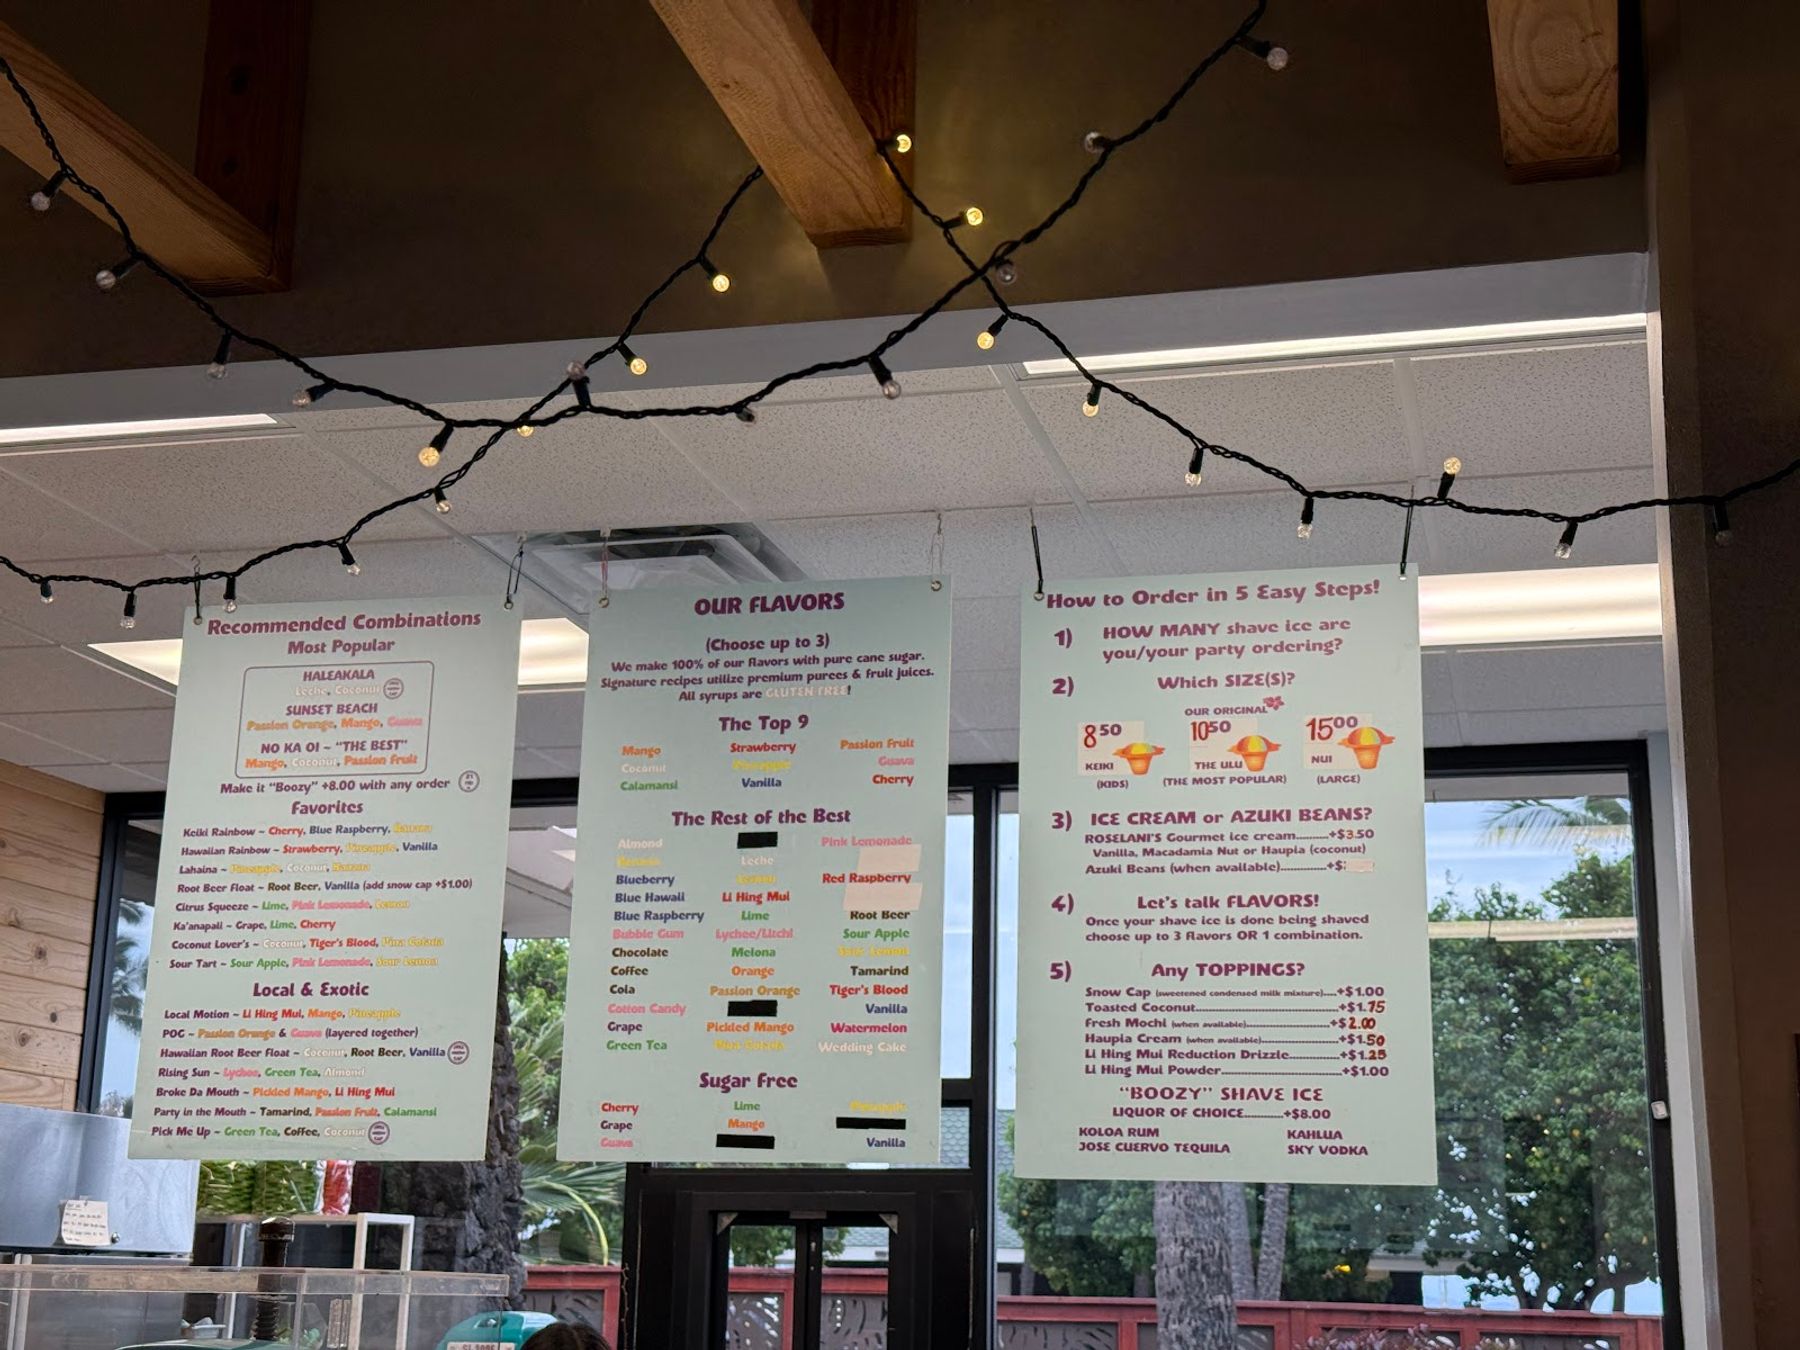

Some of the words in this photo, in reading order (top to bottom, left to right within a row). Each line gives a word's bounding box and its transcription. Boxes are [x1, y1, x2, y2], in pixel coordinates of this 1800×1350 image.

[1046, 591, 1096, 609] How
[1103, 594, 1124, 607] to
[1132, 589, 1199, 605] Order
[1207, 587, 1228, 602] in
[1236, 585, 1248, 601] 5
[1257, 584, 1306, 604] Easy
[1315, 579, 1380, 601] Steps!
[694, 597, 742, 616] OUR
[749, 592, 845, 614] FLAVORS
[207, 615, 346, 635] Recommended
[353, 611, 481, 630] Combinations
[1103, 625, 1154, 639] HOW
[1160, 623, 1220, 637] MANY
[1227, 622, 1279, 635] shave
[1285, 620, 1312, 632] ice
[1319, 620, 1350, 631] are
[288, 641, 327, 655] Most
[332, 638, 395, 657] Popular
[706, 637, 765, 654] (Choose
[770, 639, 790, 653] up
[795, 637, 811, 648] to
[816, 632, 830, 649] 3)
[1102, 645, 1189, 664] you/your
[1195, 644, 1245, 661] party
[1252, 638, 1343, 656] ordering?
[611, 662, 632, 672] We
[636, 661, 668, 671] make
[672, 659, 703, 670] 100%
[708, 659, 720, 669] of
[723, 660, 745, 668] our
[748, 655, 789, 667] flavors
[793, 654, 820, 666] with
[824, 655, 853, 668] pure
[856, 654, 885, 663] cane
[888, 652, 925, 665] sugar.
[303, 669, 375, 682] HALEAKALA
[601, 678, 657, 691] Signature
[660, 675, 703, 689] recipes
[707, 673, 744, 684] utilize
[747, 673, 803, 687] premium
[807, 671, 848, 684] purees
[852, 669, 861, 680] &
[895, 667, 934, 681] juices.
[1157, 676, 1218, 690] Which
[1225, 671, 1295, 688] SIZE(S)?
[286, 704, 333, 716] SUNSET
[336, 703, 378, 714] BEACH
[718, 716, 752, 732] The
[758, 715, 792, 735] Top
[798, 714, 809, 729] 9
[261, 743, 280, 754] NO
[284, 742, 302, 753] KA
[305, 742, 320, 753] OI
[730, 742, 796, 754] Strawberry
[1311, 755, 1332, 764] NUI
[1085, 762, 1114, 771] KEIKI
[220, 782, 254, 794] Make
[256, 782, 266, 793] it
[321, 780, 356, 791] +8.00
[359, 779, 386, 791] with
[390, 781, 412, 793] any
[416, 778, 450, 789] order
[741, 777, 782, 788] Vanilla
[872, 774, 914, 787] Cherry
[1097, 779, 1129, 790] (KIDS)
[1163, 777, 1188, 787] (THE
[1192, 776, 1226, 785] MOST
[1229, 774, 1287, 784] POPULAR)
[1317, 774, 1361, 785] (LARGE)
[291, 800, 363, 815] Favorites
[671, 811, 705, 826] The
[711, 810, 748, 826] Rest
[754, 810, 773, 825] of
[778, 809, 807, 824] the
[813, 808, 851, 823] Best
[1091, 812, 1120, 826] ICE
[1127, 811, 1196, 825] CREAM
[1203, 814, 1224, 824] or
[1230, 809, 1291, 823] AZUKI
[1299, 807, 1372, 822] BEANS?
[183, 828, 208, 838] Keiki
[211, 827, 256, 837] Rainbow
[268, 826, 306, 838] Cherry,
[309, 825, 332, 834] Blue
[335, 824, 391, 836] Raspberry,
[181, 847, 226, 856] Hawaiian
[228, 846, 271, 855] Rainbow
[402, 842, 438, 851] Vanilla
[616, 874, 675, 887] Blueberry
[822, 873, 845, 884] Red
[849, 872, 912, 884] Raspberry
[177, 884, 200, 893] Root
[203, 883, 227, 893] Beer
[230, 883, 255, 892] Float
[267, 882, 291, 891] Root
[324, 881, 360, 890] Vanilla
[363, 880, 384, 891] (add
[415, 882, 432, 892] cap
[1137, 896, 1178, 909] Let’s
[1185, 895, 1220, 909] talk
[1227, 894, 1319, 908] FLAVORS!
[1085, 930, 1130, 942] choose
[1135, 934, 1152, 944] up
[1156, 933, 1169, 941] to
[1174, 930, 1181, 941] 3
[1186, 931, 1232, 941] flavors
[1237, 930, 1258, 940] OR
[1262, 930, 1269, 940] 1
[1274, 930, 1363, 940] combination.
[612, 947, 669, 958] Chocolate
[610, 965, 649, 976] Coffee
[850, 965, 909, 976] Tamarind
[1151, 963, 1189, 982] Any
[1195, 962, 1305, 977] TOPPINGS?
[253, 983, 295, 997] Local
[300, 982, 313, 997] &
[320, 981, 369, 997] Exotic
[164, 1010, 190, 1019] Local
[193, 1009, 230, 1019] Motion
[242, 1009, 251, 1019] Li
[255, 1009, 278, 1022] Hing
[281, 1009, 304, 1019] Mui,
[830, 1022, 907, 1033] Watermelon
[699, 1072, 751, 1094] Sugar
[757, 1072, 798, 1088] Free
[1221, 1087, 1284, 1101] SHAVE
[1293, 1088, 1323, 1101] ICE
[601, 1102, 639, 1116] Cherry
[1113, 1107, 1165, 1118] LIQUOR
[1170, 1108, 1188, 1117] OF
[600, 1120, 633, 1133] Grape
[1079, 1127, 1123, 1137] KOLOA
[1128, 1127, 1159, 1137] RUM
[1287, 1129, 1343, 1140] KAHLUA
[1079, 1142, 1110, 1152] JOSE
[1115, 1142, 1169, 1152] CUERVO
[1174, 1143, 1230, 1154] TEQUILA
[1288, 1145, 1314, 1155] SKY
[1318, 1145, 1368, 1156] VODKA
